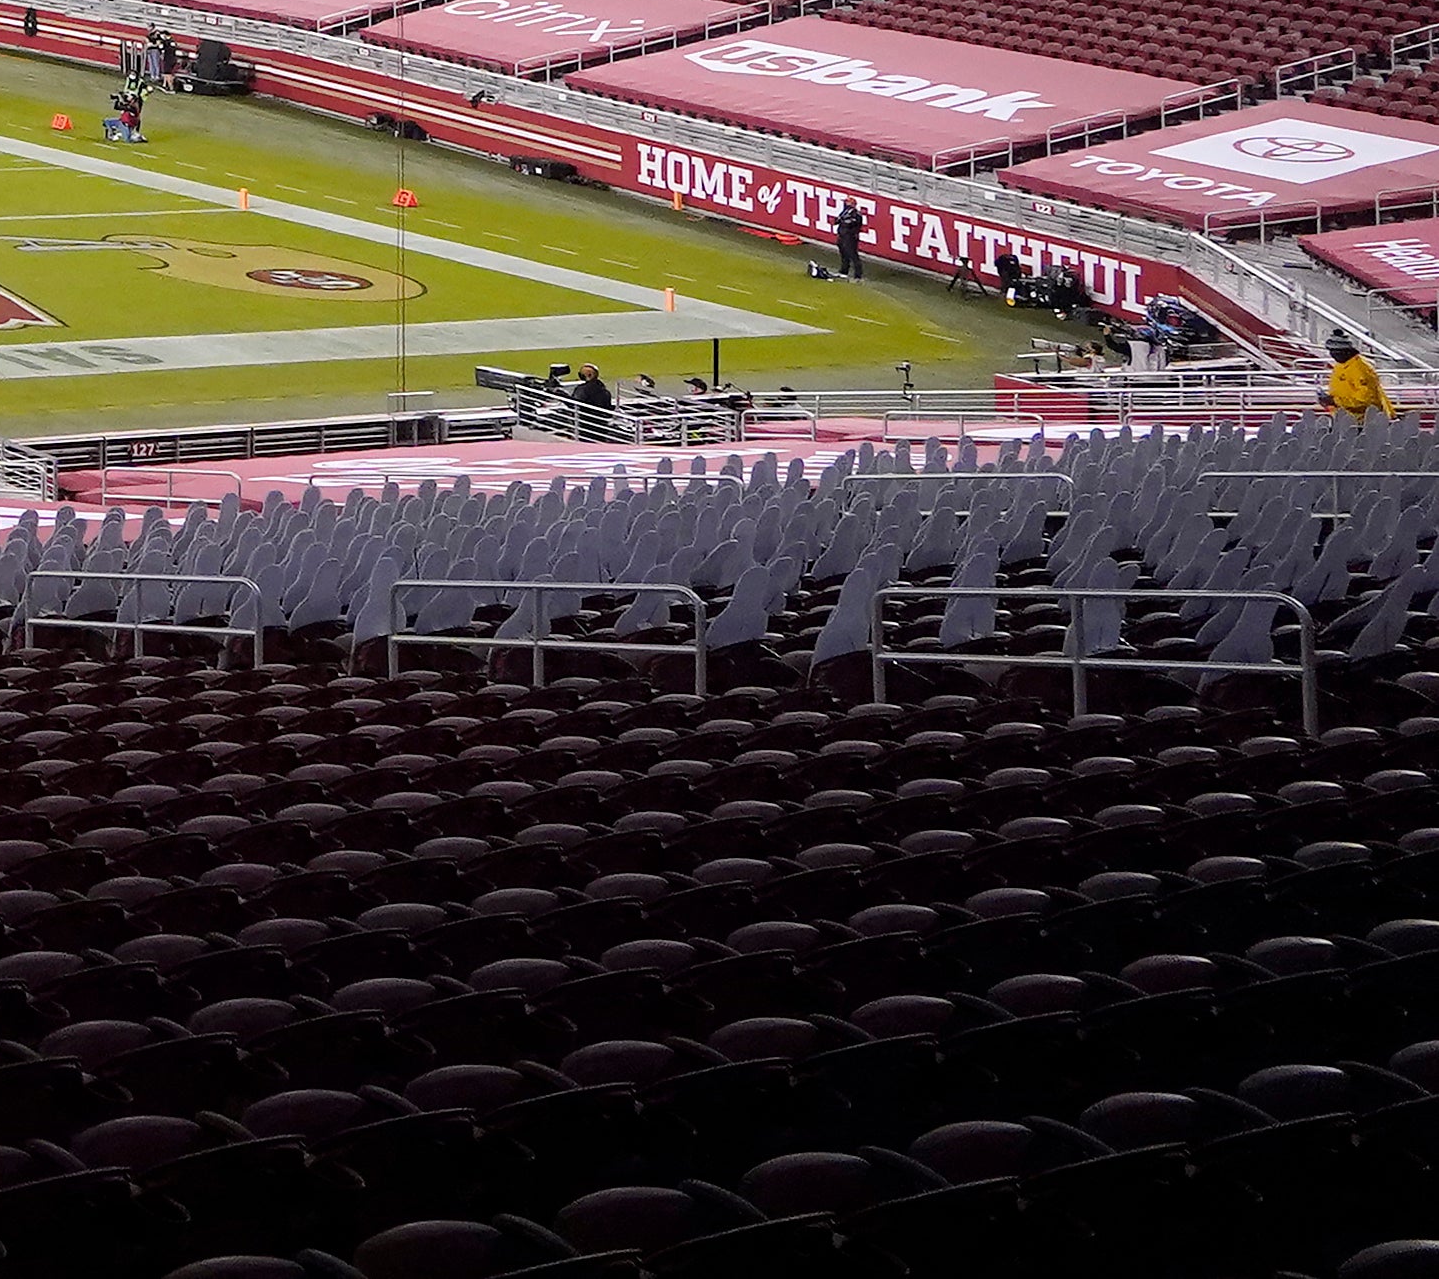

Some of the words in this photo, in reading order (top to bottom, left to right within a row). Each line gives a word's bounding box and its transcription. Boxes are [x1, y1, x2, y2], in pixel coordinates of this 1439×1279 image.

[1073, 154, 1278, 209] TOYOTA
[1034, 203, 1054, 215] 122
[637, 143, 753, 213] HOME
[757, 182, 783, 215] of
[784, 180, 877, 245] THE
[890, 207, 1152, 316] FAITHFUL
[130, 443, 157, 457] 127
